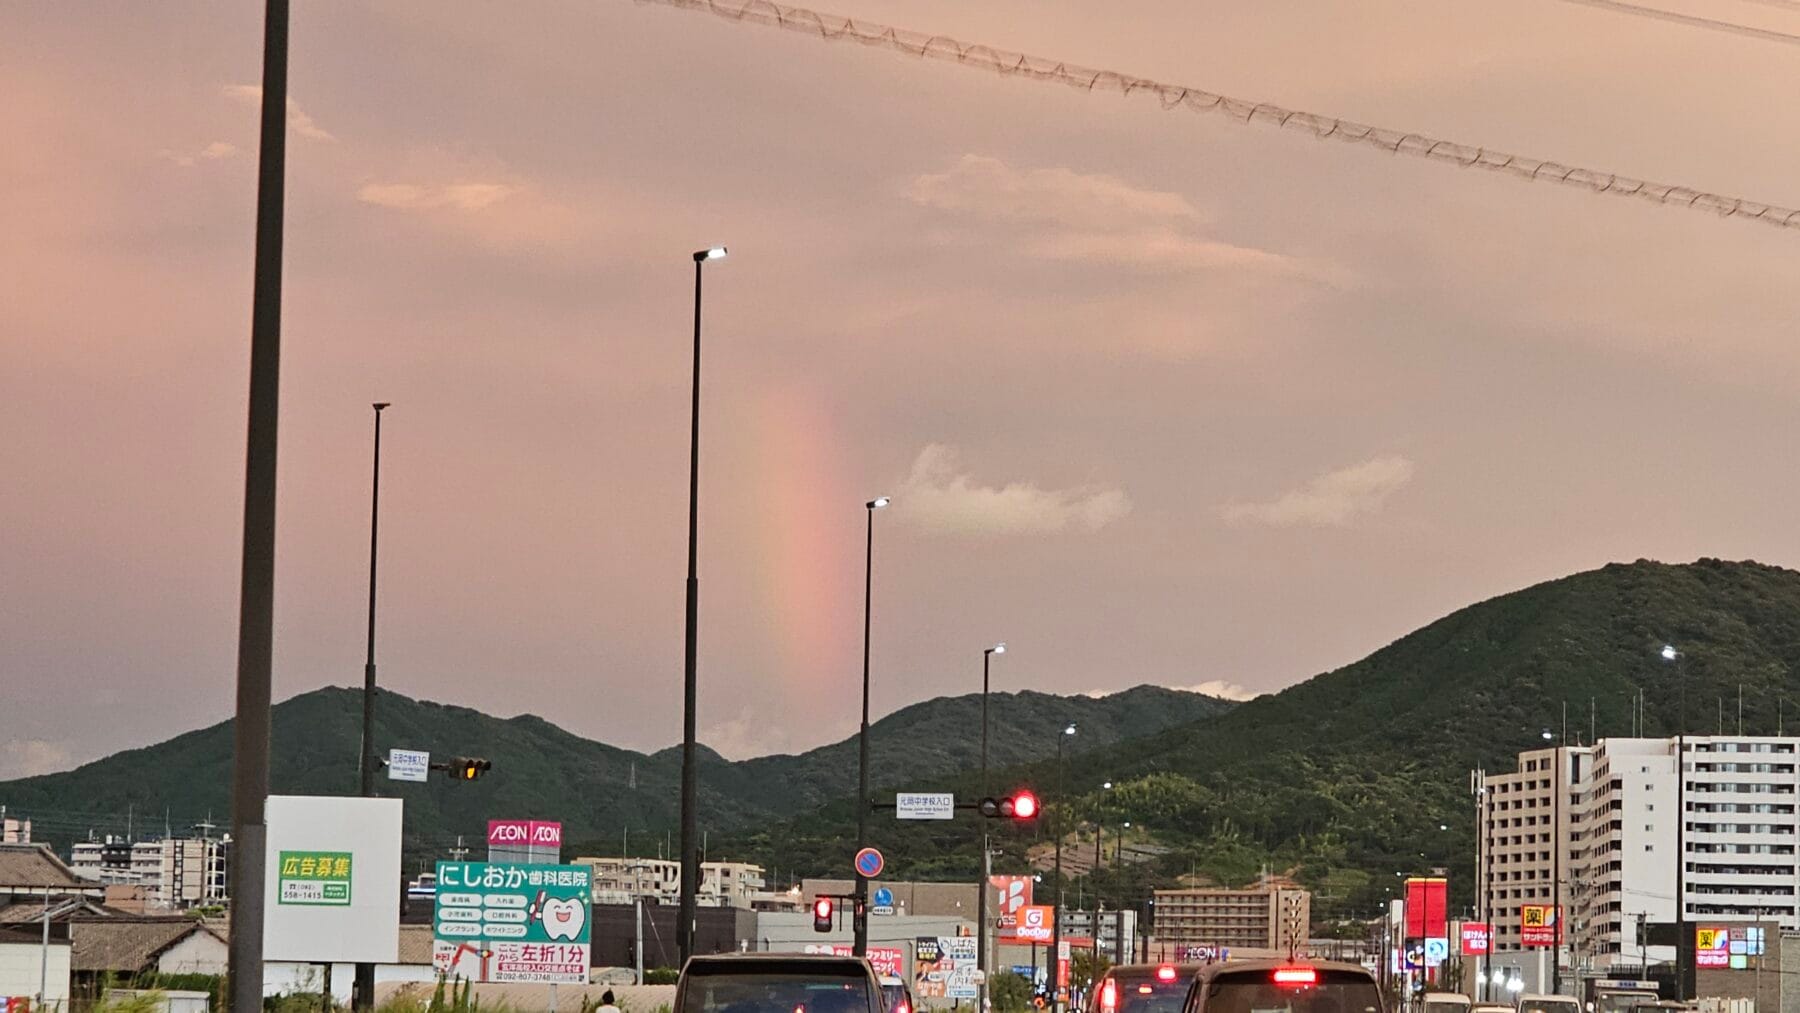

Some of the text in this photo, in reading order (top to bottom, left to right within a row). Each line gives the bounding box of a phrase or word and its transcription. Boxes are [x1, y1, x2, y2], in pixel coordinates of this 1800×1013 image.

[283, 856, 350, 877] 広告募集
[439, 864, 588, 888] にしおか歯科医院
[498, 944, 518, 953] ここ
[498, 953, 519, 962] から
[522, 944, 584, 963] 左折1分
